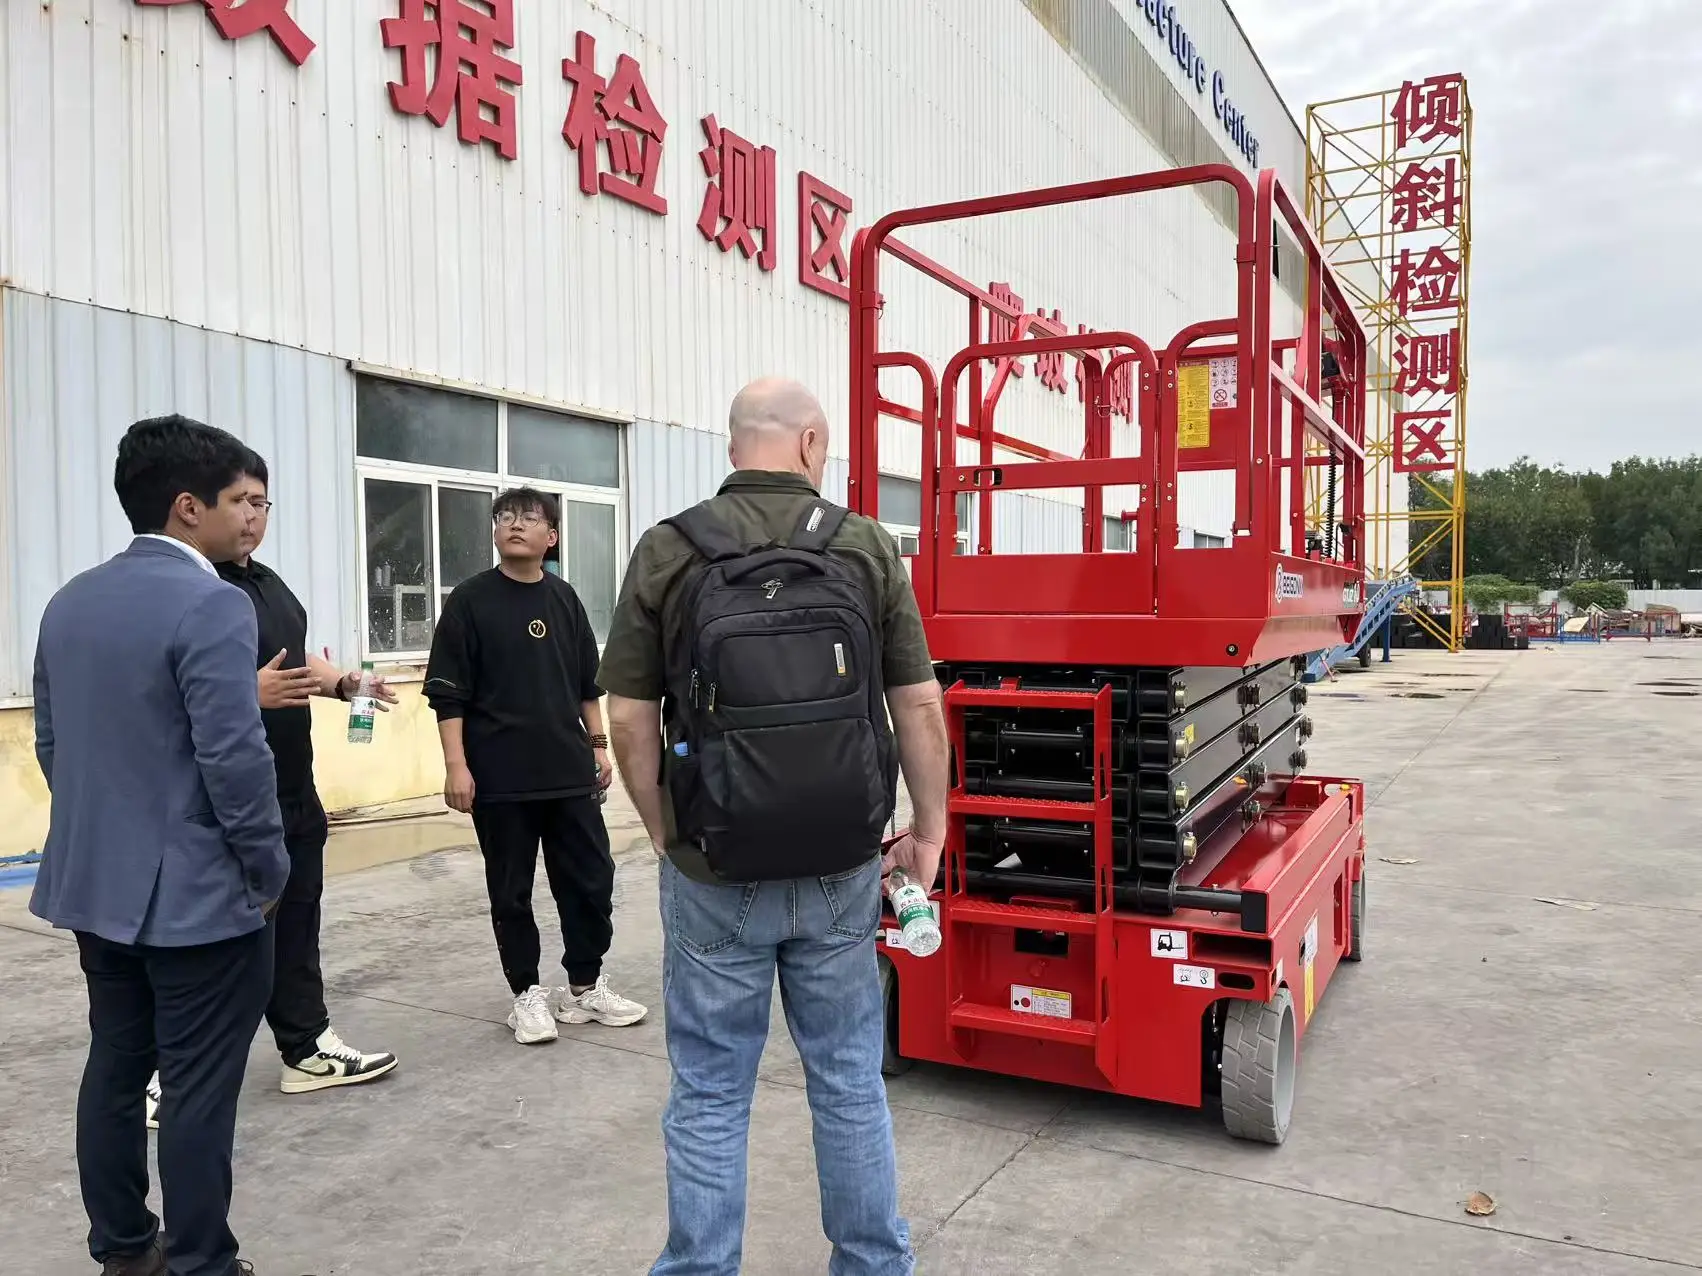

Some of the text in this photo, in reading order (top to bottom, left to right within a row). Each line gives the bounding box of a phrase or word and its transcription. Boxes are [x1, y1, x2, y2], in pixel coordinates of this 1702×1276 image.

[134, 0, 852, 303] 据检测区
[1213, 70, 1259, 169] Center
[1389, 72, 1463, 473] 倾斜检测区
